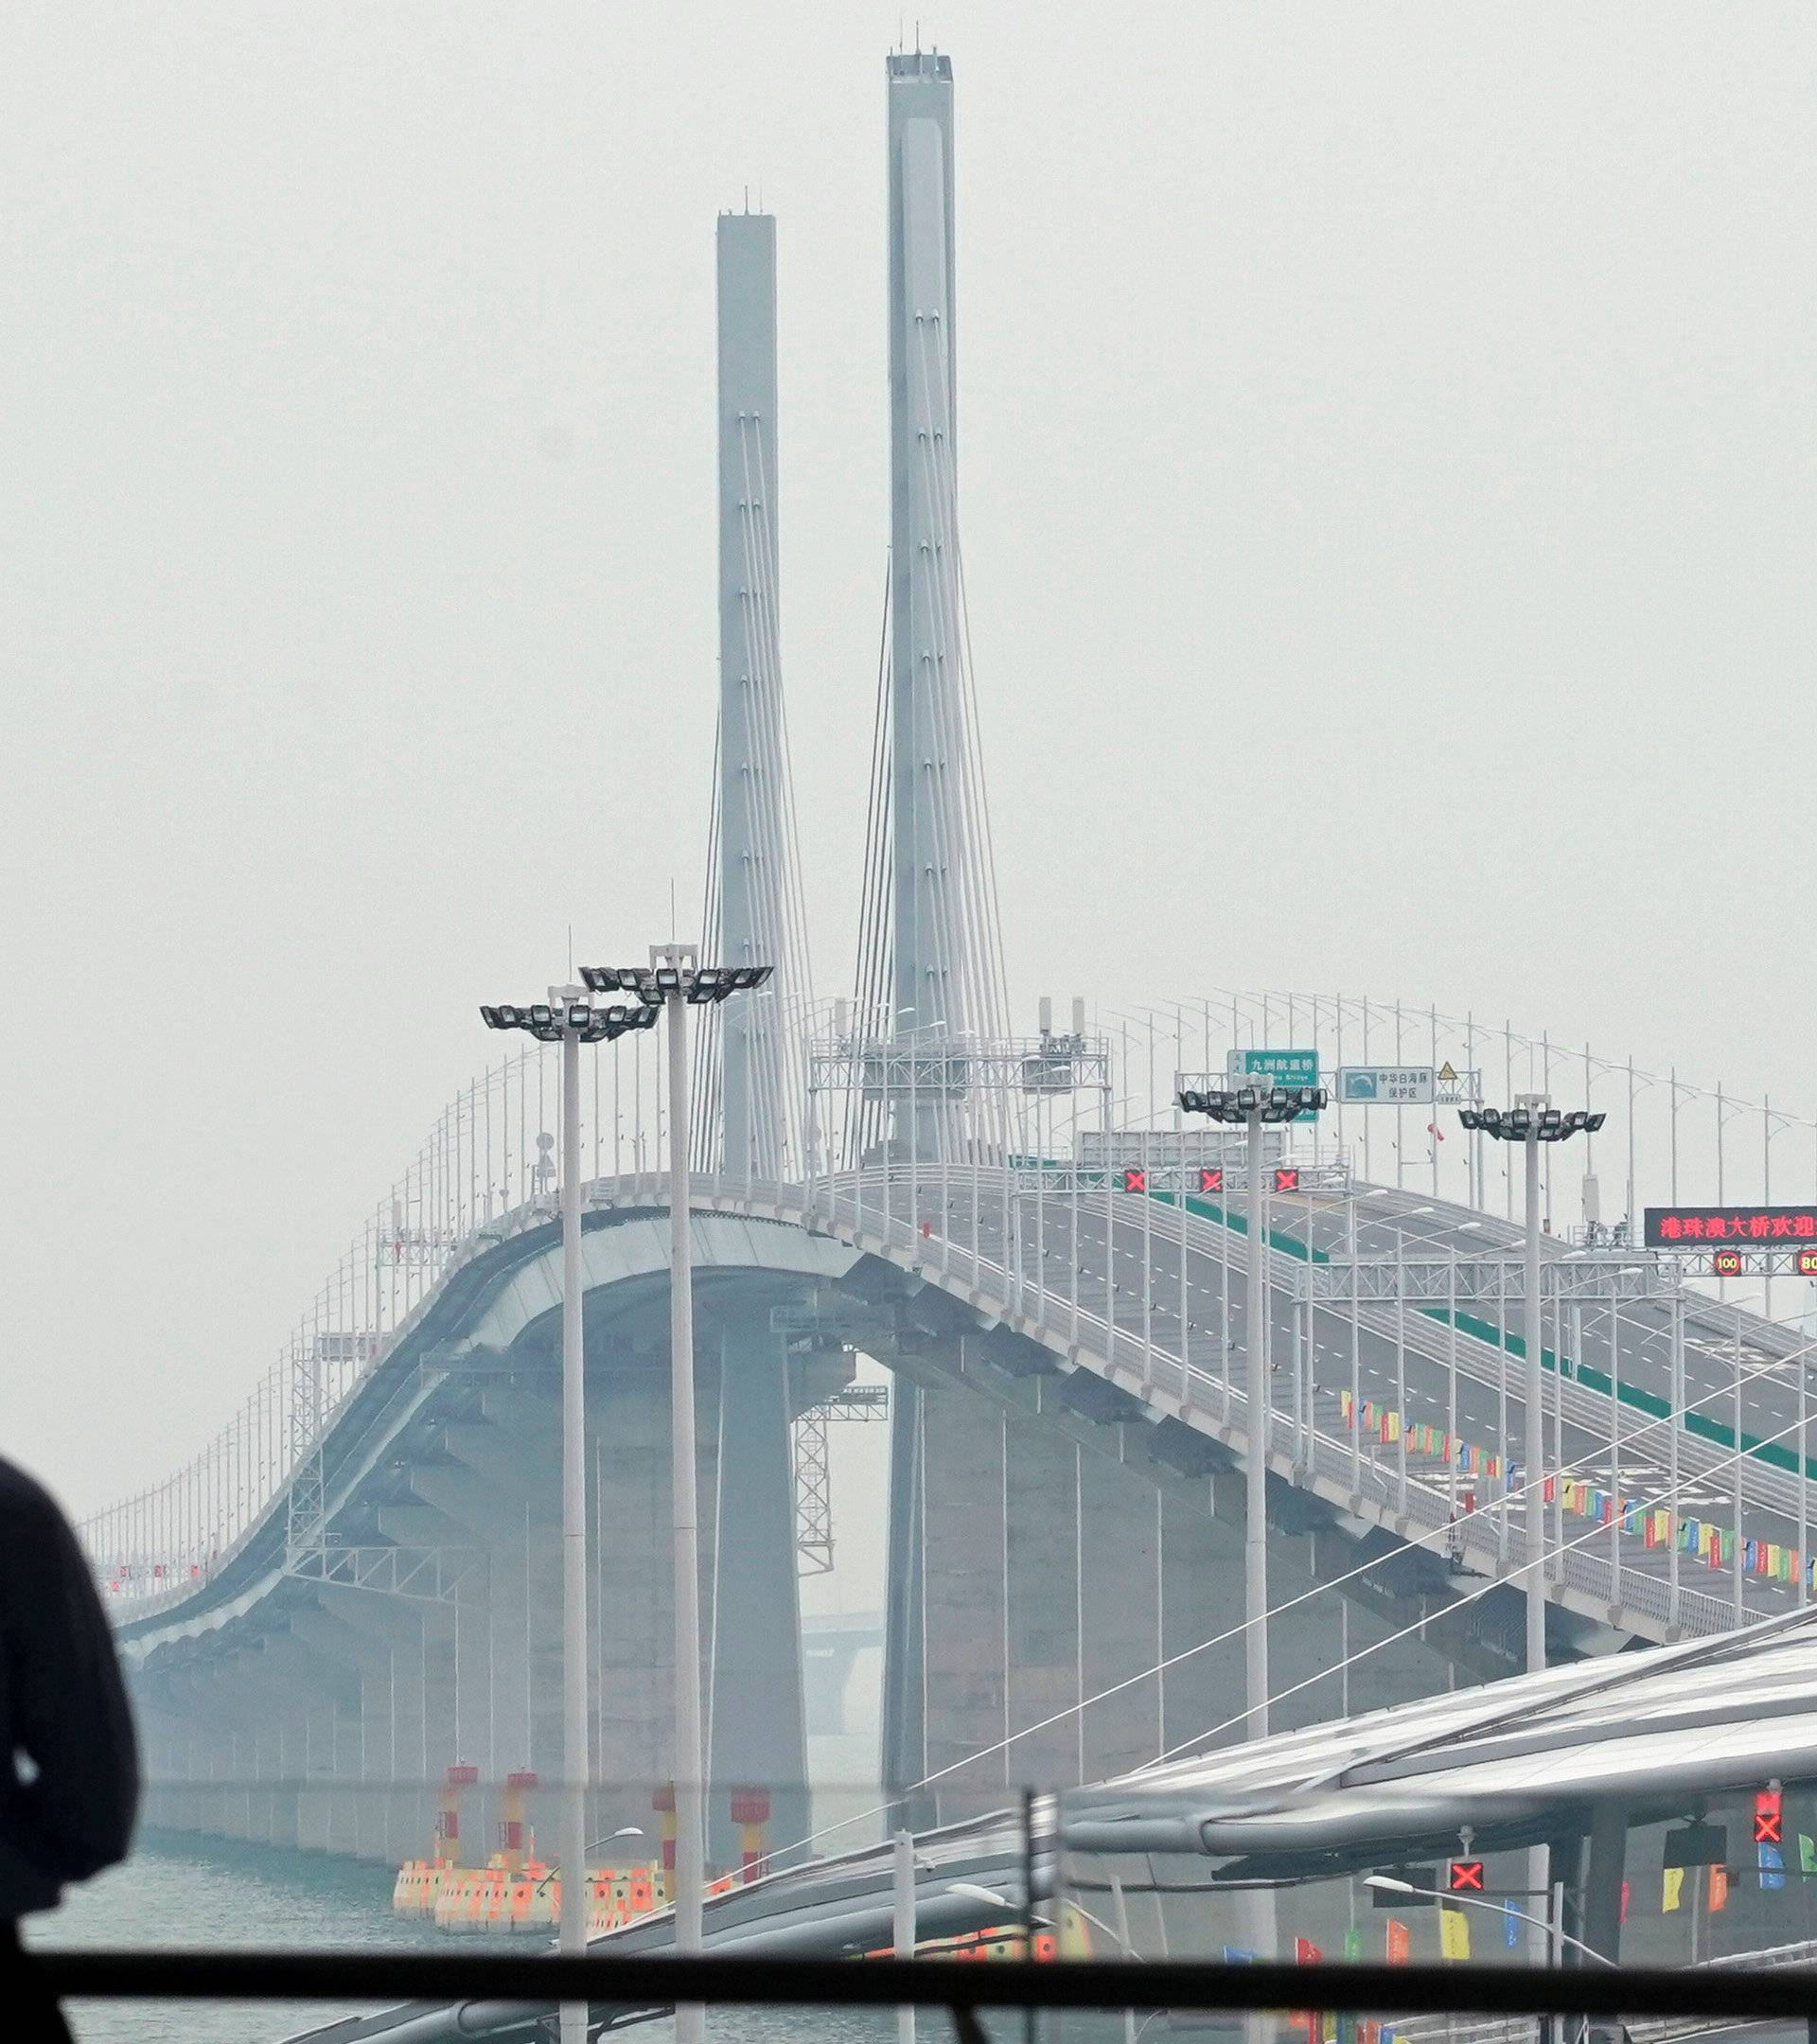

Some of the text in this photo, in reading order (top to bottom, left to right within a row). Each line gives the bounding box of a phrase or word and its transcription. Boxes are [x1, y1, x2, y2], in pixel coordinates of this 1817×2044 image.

[1379, 1072, 1427, 1084] 中华白海豚
[1388, 1087, 1417, 1099] 保护区
[1661, 1215, 1817, 1239] 港珠澳大桥欢迎
[1717, 1258, 1737, 1269] 100
[1801, 1258, 1817, 1269] 80
